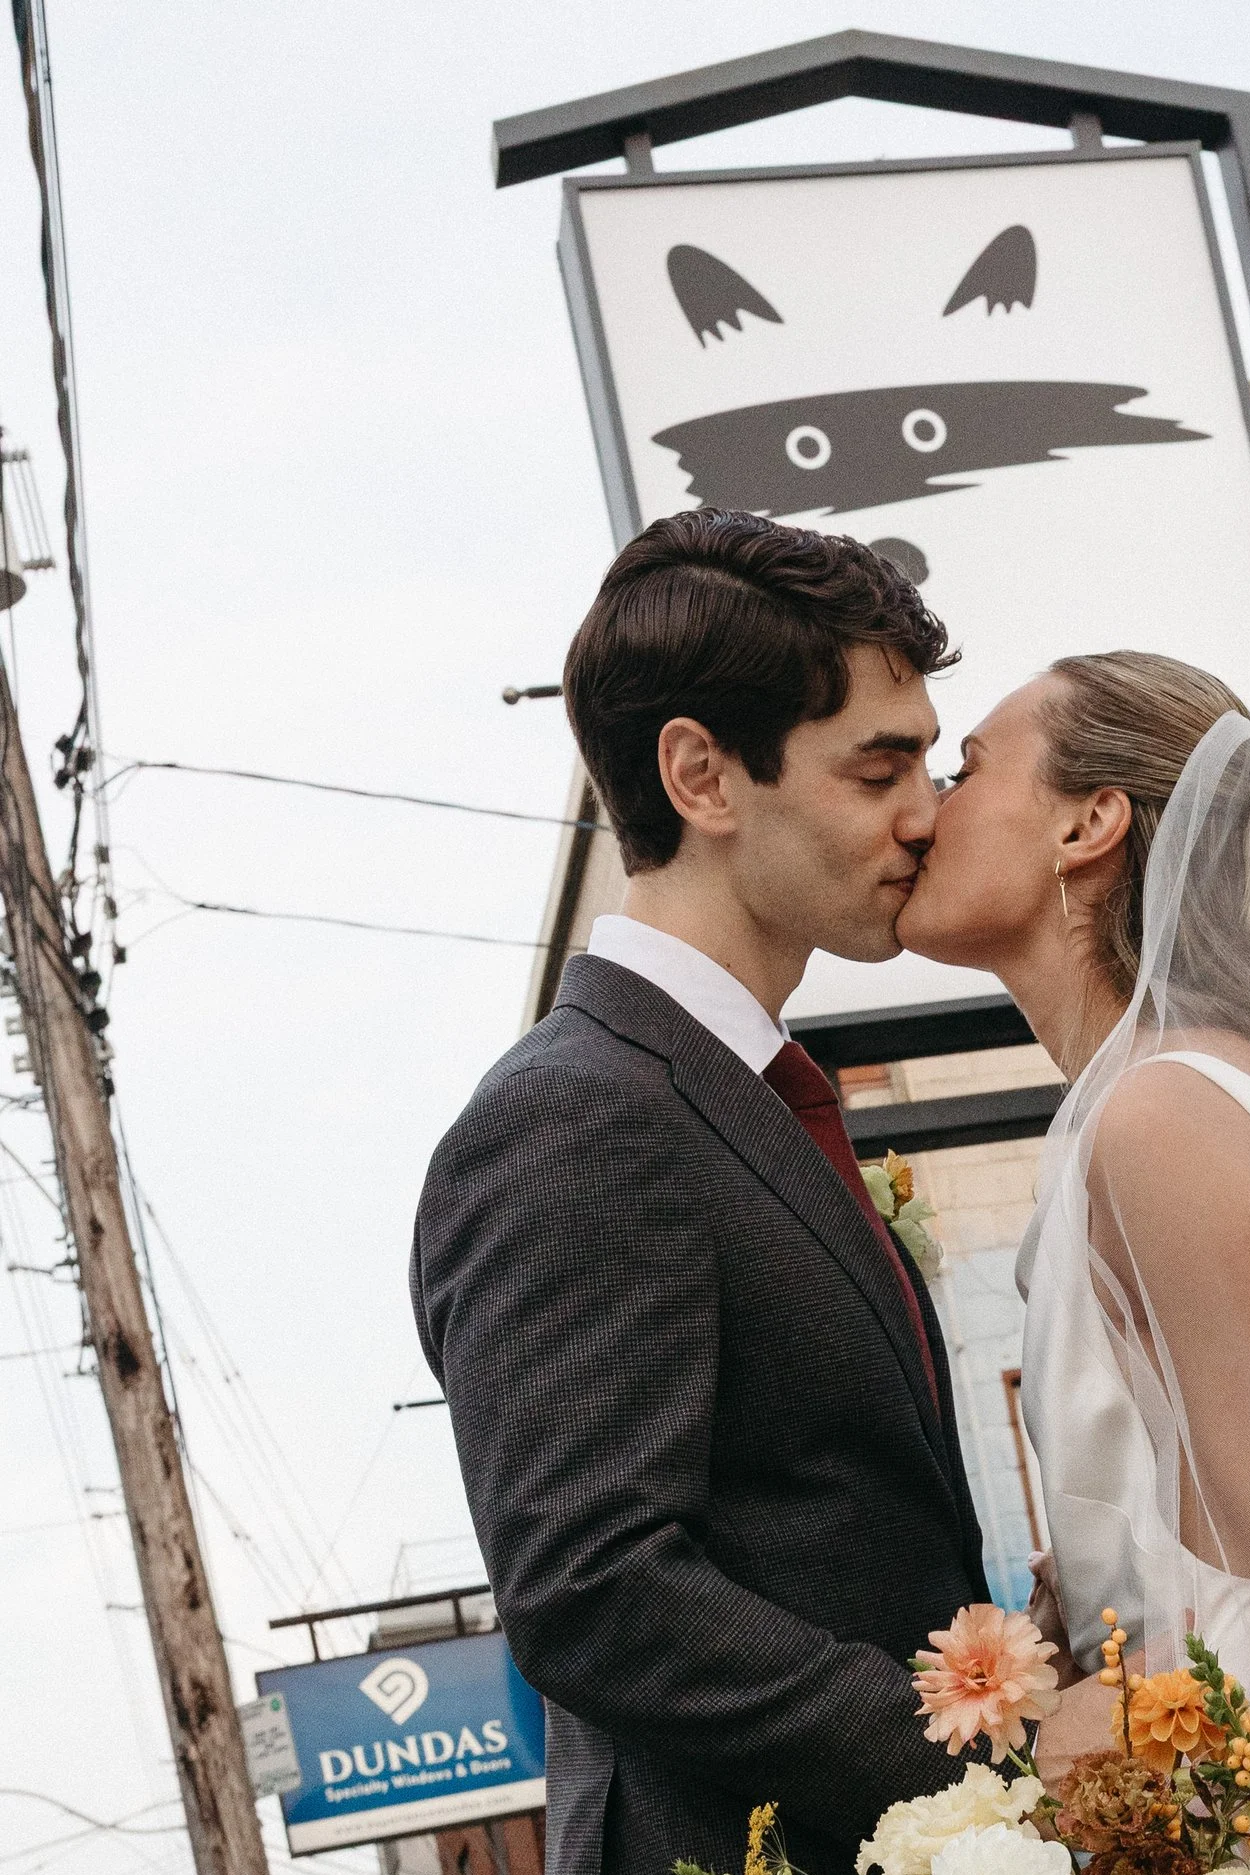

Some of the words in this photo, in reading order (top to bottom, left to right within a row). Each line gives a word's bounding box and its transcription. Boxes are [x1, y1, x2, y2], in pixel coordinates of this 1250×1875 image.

[319, 1719, 508, 1784] DUNDAS
[324, 1774, 389, 1803] Specialty
[391, 1765, 453, 1788] Windows
[455, 1757, 468, 1778] &
[469, 1756, 512, 1775] Doors
